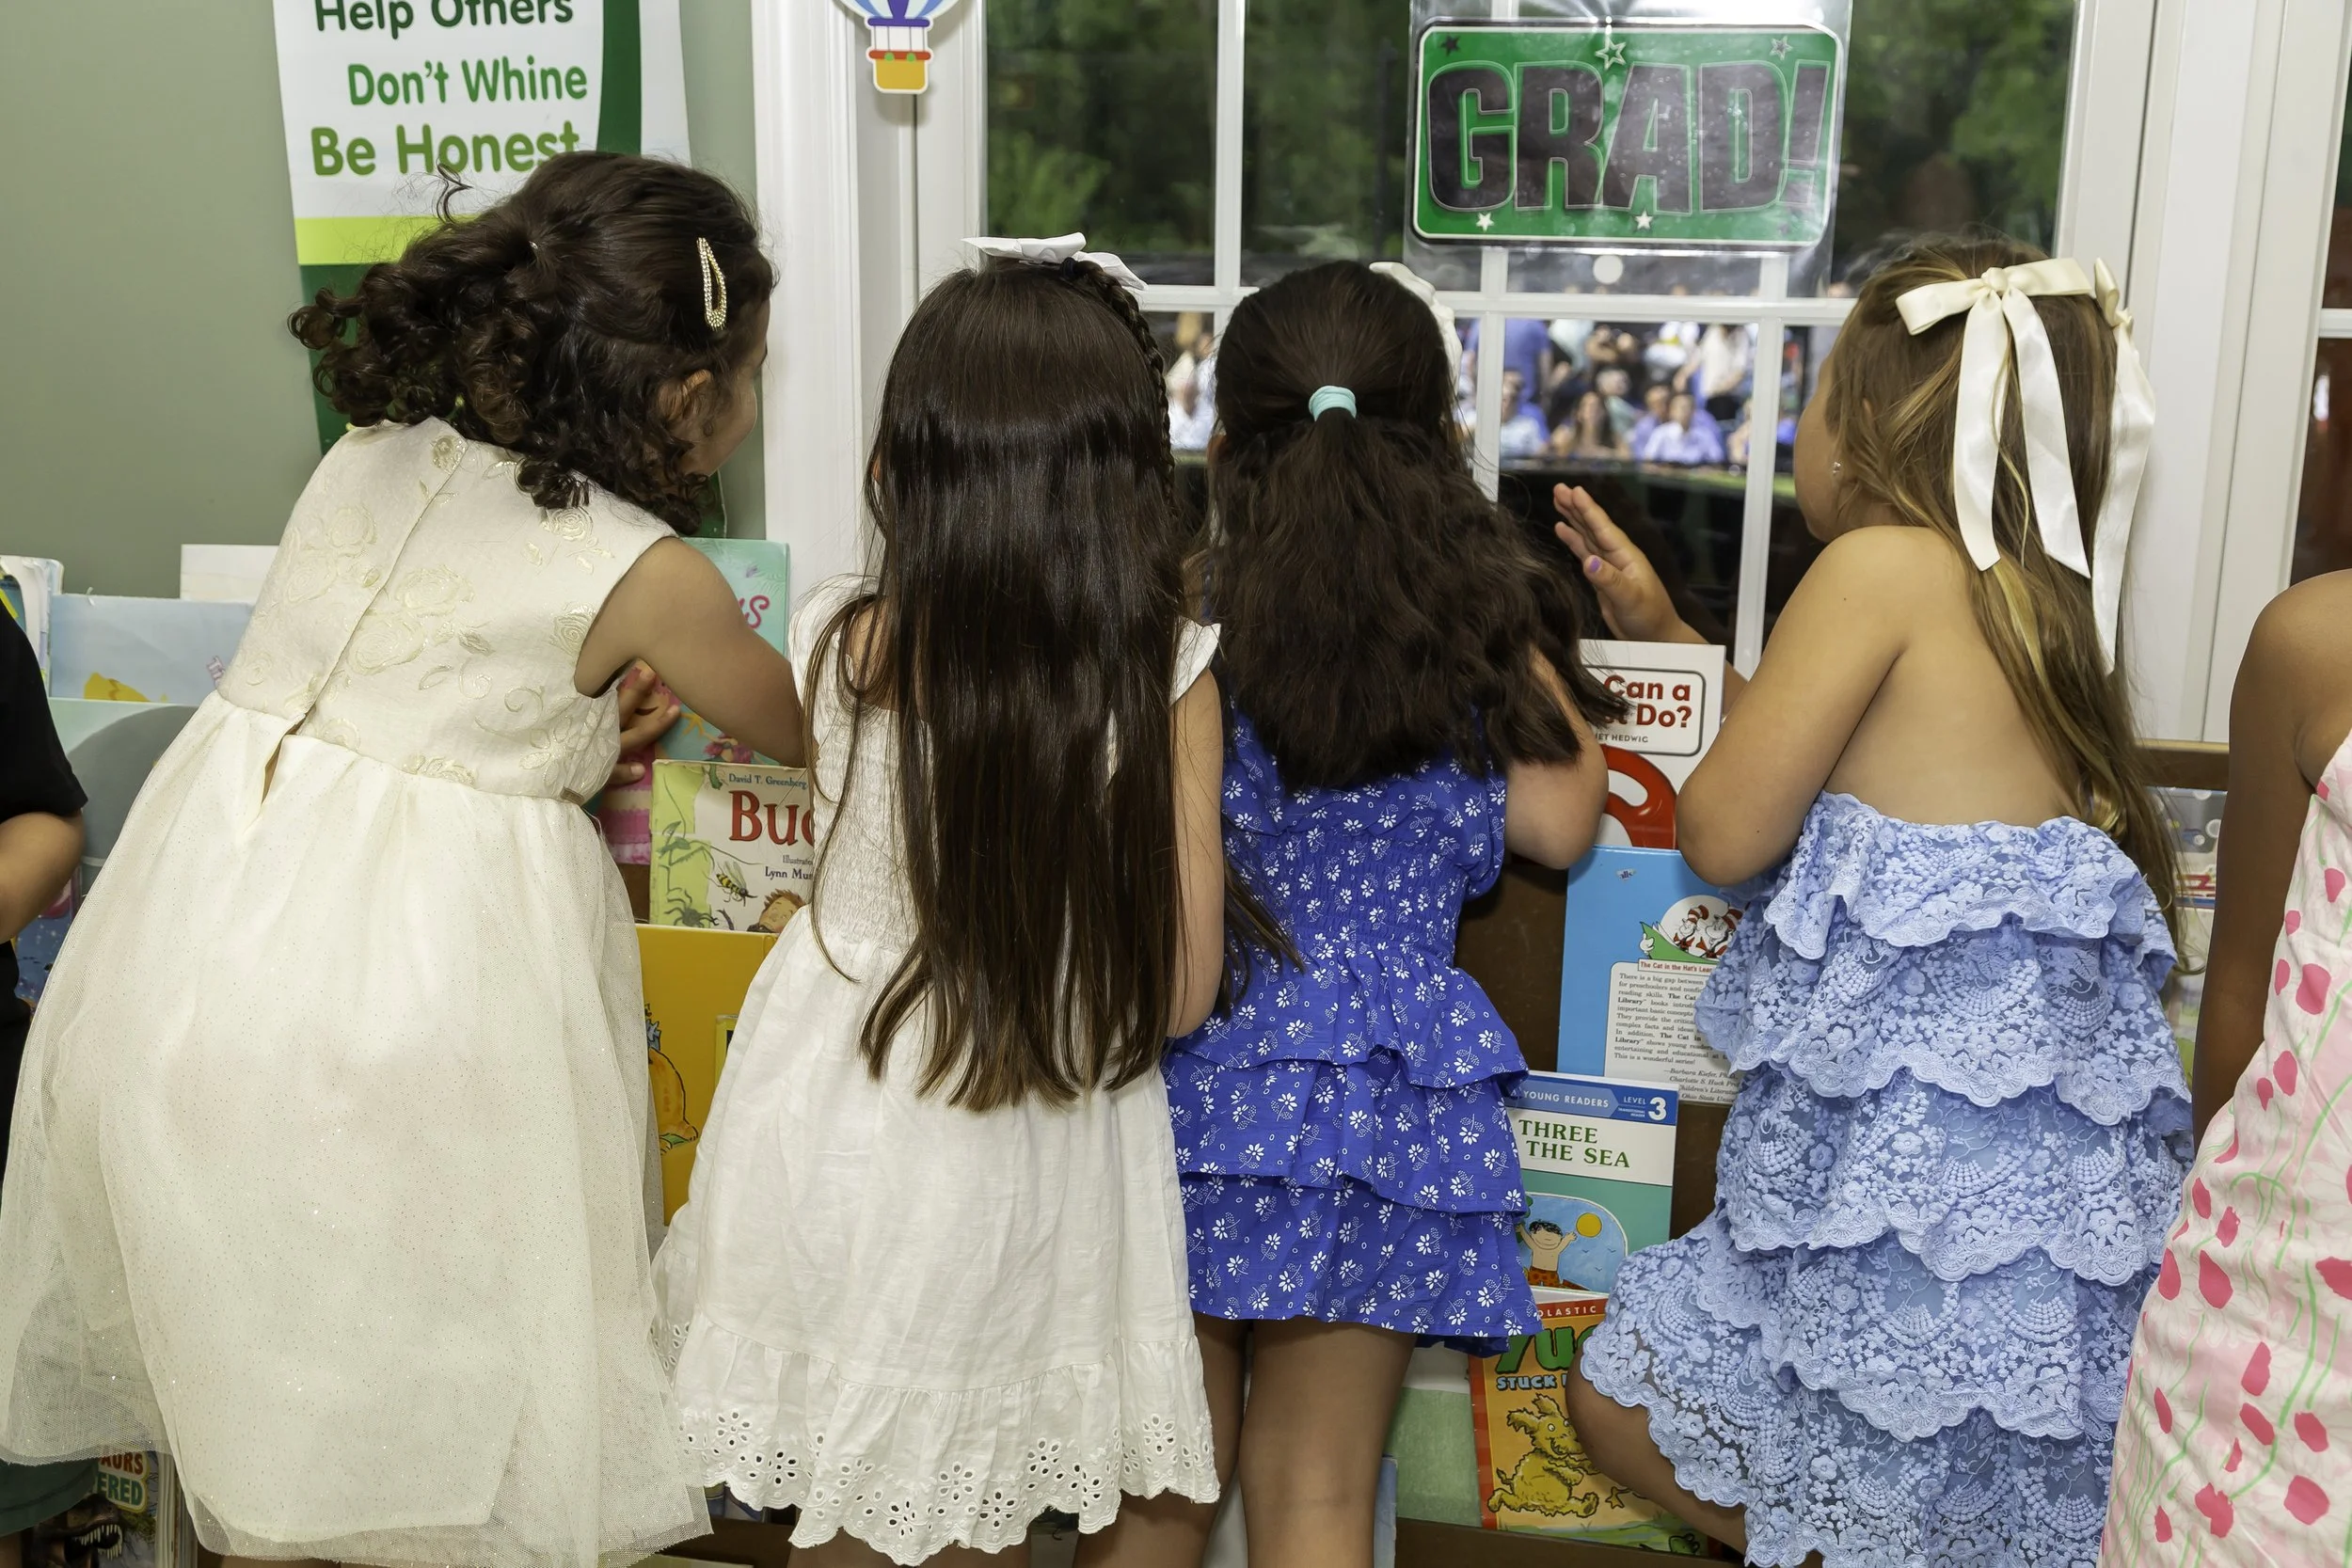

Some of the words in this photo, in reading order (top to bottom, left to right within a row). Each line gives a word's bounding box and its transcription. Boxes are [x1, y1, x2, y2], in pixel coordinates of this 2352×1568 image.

[314, 0, 414, 40] Help
[431, 0, 574, 27] Others
[348, 60, 450, 105] Don't
[461, 55, 588, 102] Whine
[310, 126, 376, 176] Be
[396, 120, 580, 174] Honest
[1427, 58, 1832, 217] GRAD!
[1603, 674, 1664, 701] Can
[1672, 684, 1692, 702] a
[1635, 703, 1692, 729] Do?
[1611, 734, 1649, 744] HEDWIG
[728, 773, 752, 784] David
[754, 775, 763, 784] T.
[765, 776, 808, 791] Greenberg
[765, 865, 788, 880] Lynn
[1640, 960, 1652, 969] The
[1616, 1012, 1632, 1021] They
[1613, 1046, 1654, 1054] entertaining
[1672, 1050, 1709, 1058] educational
[1643, 1055, 1675, 1064] wonderful
[1523, 1090, 1561, 1102] YOUNG
[1564, 1095, 1610, 1109] READERS
[1623, 1095, 1646, 1105] LEVEL
[1647, 1096, 1667, 1121] 3
[1518, 1118, 1598, 1145] THREE
[1525, 1139, 1574, 1162] THE
[1582, 1147, 1630, 1168] SEA
[1496, 1373, 1558, 1391] STUCK
[98, 1450, 144, 1476] AURS
